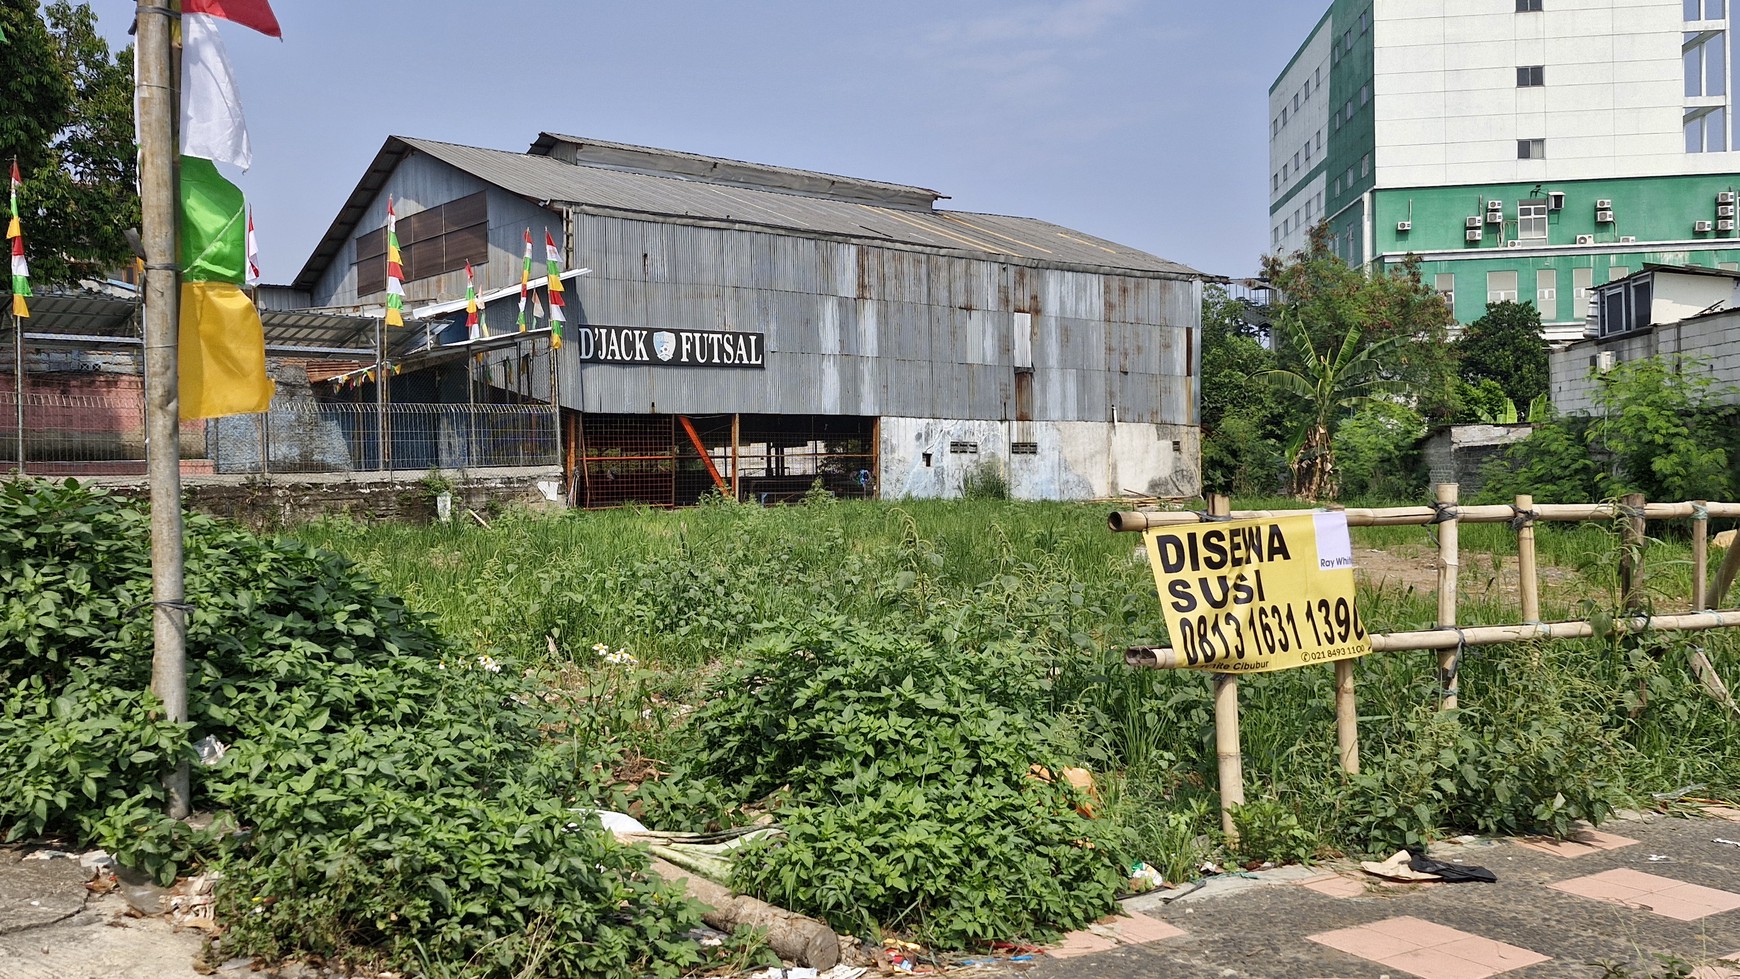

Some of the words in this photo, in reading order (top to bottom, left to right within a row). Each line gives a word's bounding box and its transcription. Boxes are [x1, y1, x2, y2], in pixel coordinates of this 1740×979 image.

[579, 328, 649, 361] D'JACK
[680, 332, 762, 365] FUTSAL
[1156, 524, 1291, 574] DISEWA
[1320, 558, 1334, 568] Ray
[1168, 569, 1265, 613] SUSI
[1233, 661, 1269, 670] Cibubur
[1311, 651, 1326, 660] 021
[1327, 648, 1346, 658] 8493
